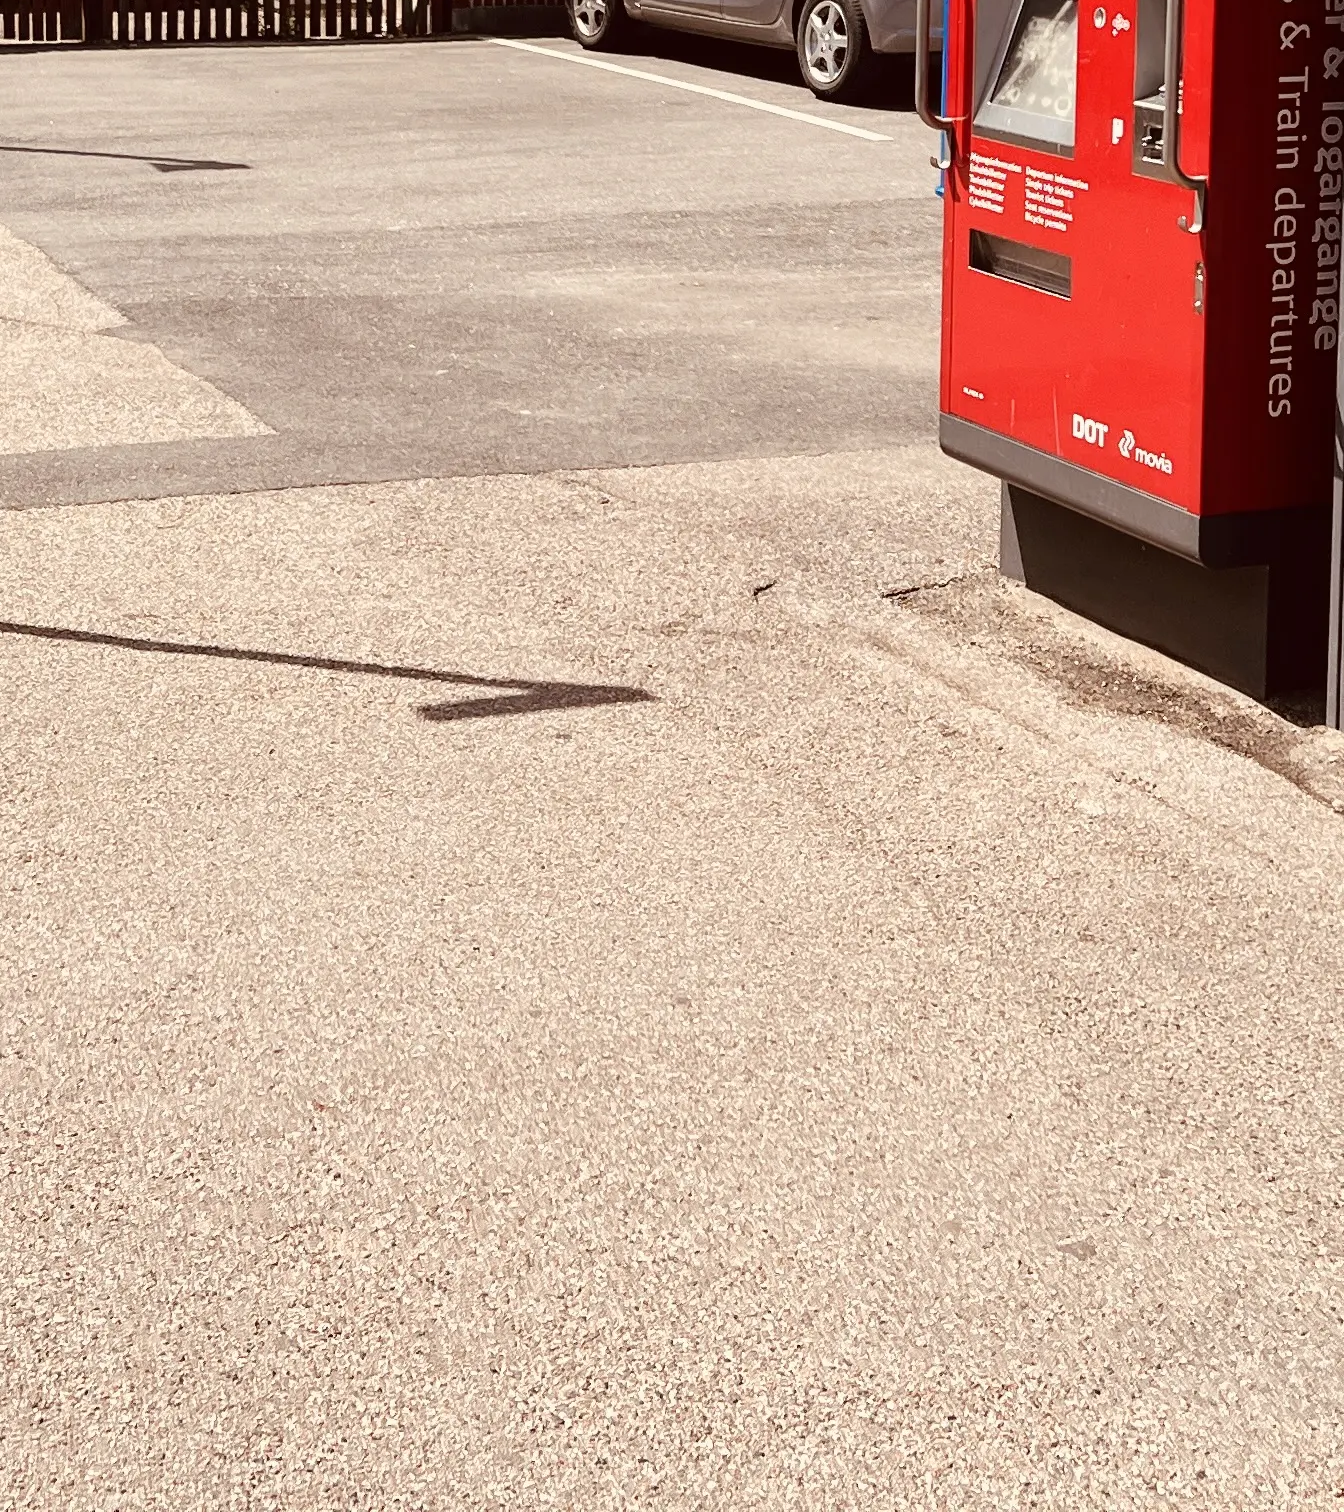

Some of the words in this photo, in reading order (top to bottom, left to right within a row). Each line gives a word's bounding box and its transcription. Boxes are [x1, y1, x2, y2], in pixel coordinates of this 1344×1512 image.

[1279, 21, 1310, 50] &
[1276, 66, 1309, 169] Train
[1265, 187, 1305, 418] departures
[1072, 413, 1108, 448] DOT
[1135, 445, 1173, 475] movia
